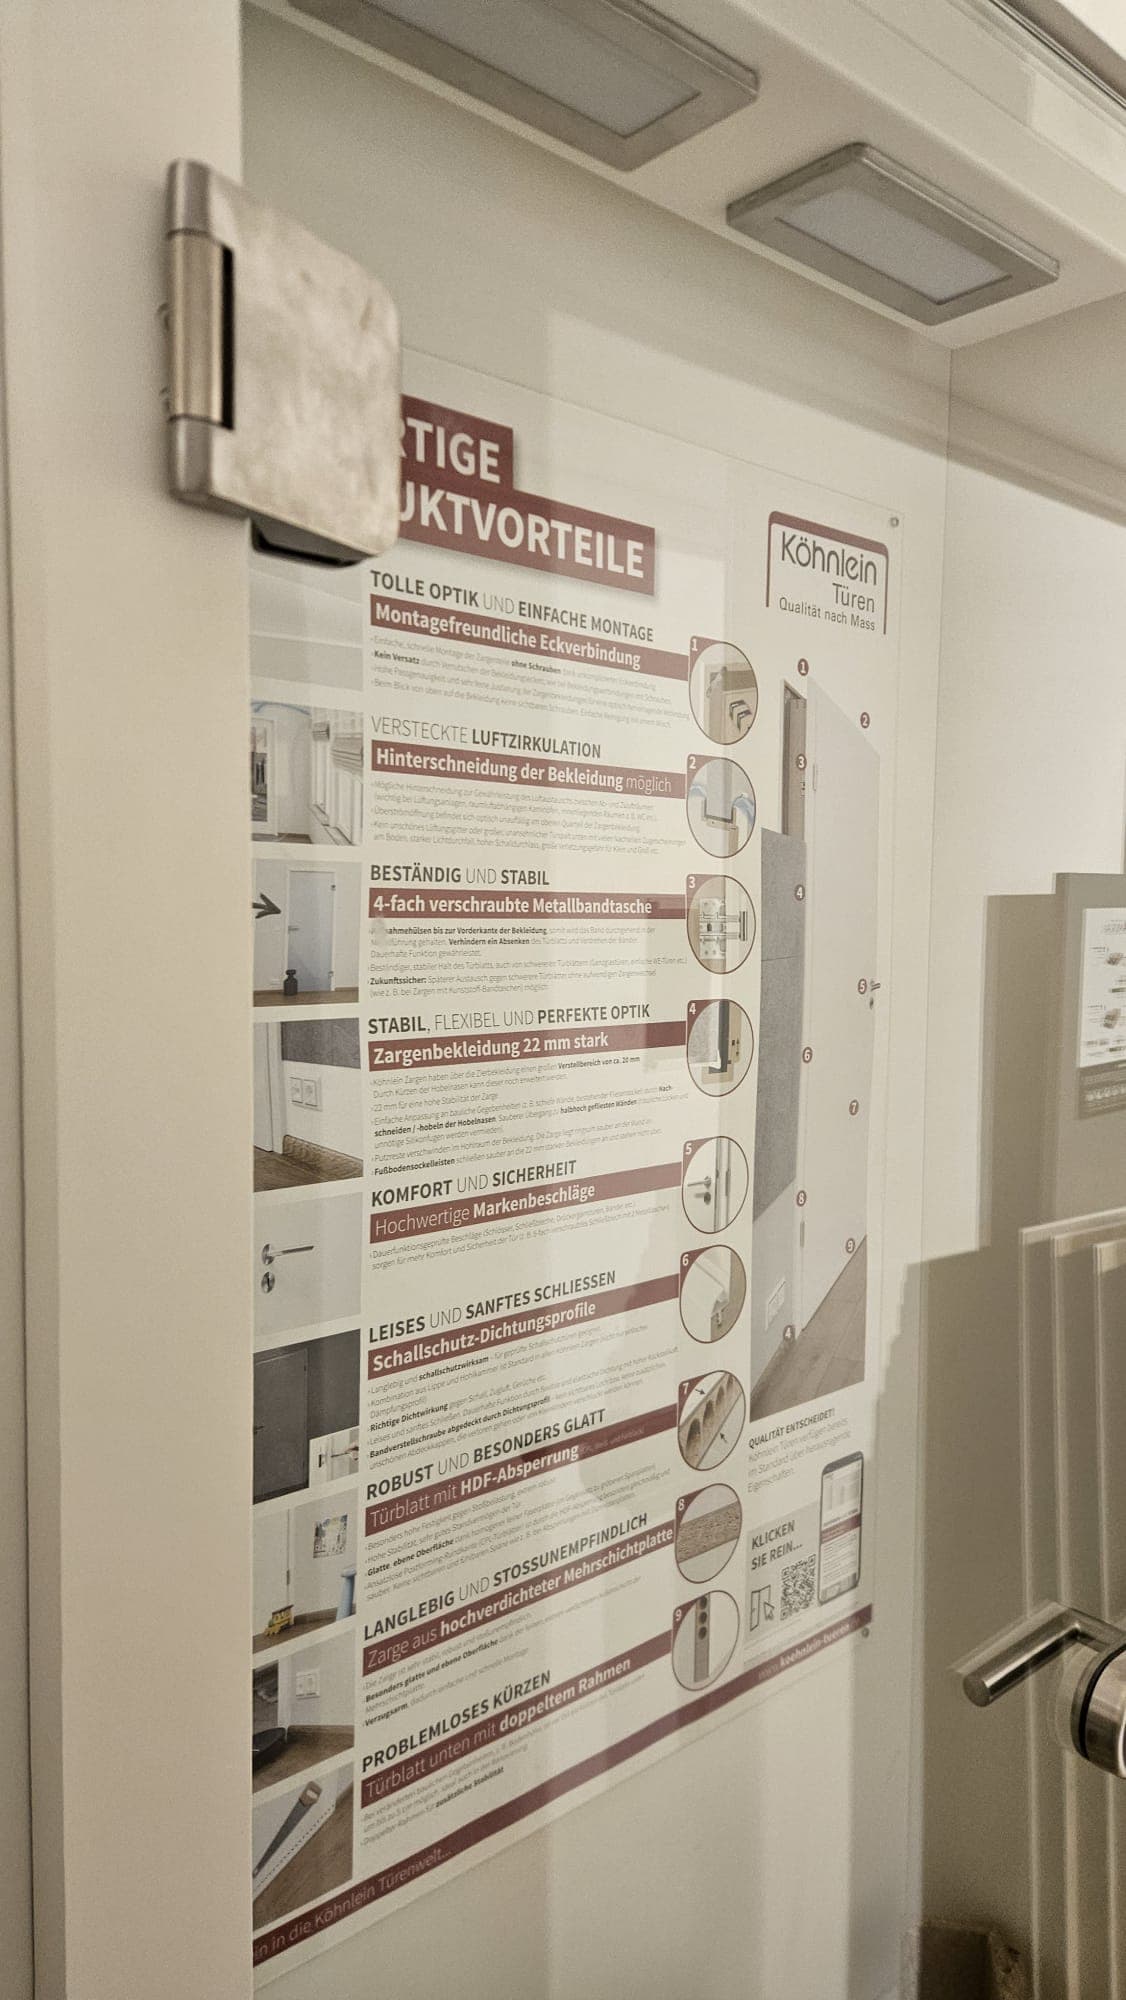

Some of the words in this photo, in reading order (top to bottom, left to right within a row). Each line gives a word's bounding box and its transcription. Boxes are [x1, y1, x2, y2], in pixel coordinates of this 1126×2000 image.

[400, 416, 501, 483] TIGE
[781, 531, 877, 586] Köhnlein
[370, 570, 425, 596] TOLLE
[428, 582, 480, 608] OPTIK
[482, 592, 515, 614] UND
[518, 600, 588, 629] EINFACHE
[590, 616, 655, 643] MONTAGE
[779, 596, 821, 618] Qualität
[824, 610, 848, 624] nach
[850, 613, 876, 631] Mass
[832, 582, 875, 613] Türen
[374, 602, 537, 649] Montagefreundliche
[539, 629, 641, 671] Eckverbindung
[691, 638, 699, 652] 1
[374, 649, 392, 660] Kein
[392, 653, 421, 665] Versatz
[370, 715, 469, 744] VERSTECKTE
[471, 728, 601, 759] LUFTZIRKULATION
[376, 747, 518, 782] Hinterschneidung
[520, 763, 546, 781] der
[547, 765, 625, 792] Bekleidung
[625, 775, 672, 795] möglich
[689, 755, 697, 770] 2
[370, 862, 462, 884] BESTÄNDIG
[464, 867, 498, 885] UND
[500, 868, 550, 886] STABIL
[688, 876, 696, 889] 3
[373, 895, 426, 912] 4-fach
[429, 896, 530, 913] verschraubte
[532, 897, 653, 914] Metallbandtasche
[433, 927, 445, 935] bis
[499, 927, 511, 935] der
[367, 1015, 431, 1035] STABIL,
[434, 1011, 500, 1031] FLEXIBEL
[503, 1010, 534, 1027] UND
[537, 1006, 608, 1025] PERFEKTE
[610, 1003, 651, 1020] OPTIK
[688, 1002, 697, 1015] 4
[373, 1038, 521, 1067] Zargenbekleidung
[523, 1037, 541, 1053] 22
[543, 1038, 571, 1051] mm
[573, 1031, 609, 1049] stark
[374, 1125, 412, 1137] schneiden
[416, 1121, 444, 1133] -hobeln
[444, 1120, 457, 1129] der
[457, 1115, 497, 1128] Hobelnasen
[684, 1142, 693, 1156] 5
[371, 1179, 453, 1207] KOMFORT
[456, 1174, 489, 1193] UND
[492, 1159, 577, 1187] SICHERHEIT
[374, 1157, 456, 1176] Fußbodensockelleisten
[375, 1207, 471, 1237] Hochwertige
[472, 1183, 596, 1219] Markenbeschläge
[681, 1253, 690, 1267] 6
[369, 1315, 426, 1344] LEISES
[429, 1307, 462, 1329] UND
[465, 1290, 531, 1320] SANFTES
[534, 1270, 616, 1303] SCHLIESSEN
[372, 1301, 597, 1372] Schallschutz-Dichtungsprofile
[418, 1356, 489, 1382] schallschutzwirksam
[682, 1382, 690, 1395] 7
[369, 1417, 400, 1433] Richtige
[401, 1403, 449, 1423] Dichtwirkung
[369, 1429, 447, 1458] Bandverstellschraube
[447, 1418, 482, 1434] abgedeckt
[482, 1411, 502, 1422] durch
[748, 1425, 786, 1449] QUALITÄT
[785, 1407, 836, 1434] ENTSCHEIDET!
[366, 1464, 434, 1501] ROBUST
[437, 1452, 470, 1476] UND
[473, 1422, 561, 1464] BESONDERS
[563, 1408, 606, 1434] GLATT
[370, 1494, 431, 1528] Türblatt
[433, 1484, 458, 1505] mit
[460, 1444, 580, 1496] HDF-Absperrung
[677, 1498, 685, 1511] 8
[751, 1520, 796, 1550] KLICKEN
[392, 1553, 416, 1568] ebene
[751, 1552, 767, 1571] SIE
[769, 1540, 803, 1562] REIN...
[364, 1590, 455, 1641] LANGLEBIG
[458, 1576, 491, 1601] UND
[493, 1512, 648, 1587] STOSSUNEMPFINDLICH
[367, 1640, 410, 1668] Zarge
[412, 1628, 438, 1650] aus
[440, 1576, 562, 1638] hochverdichteter
[564, 1527, 674, 1585] Mehrschichtplatte
[675, 1608, 683, 1622] 9
[365, 1681, 404, 1703] Besonders
[404, 1672, 426, 1688] glatte
[426, 1664, 441, 1677] und
[441, 1655, 462, 1669] ebene
[462, 1638, 499, 1659] Oberfläche
[361, 1698, 489, 1774] PROBLEMLOSES
[492, 1670, 551, 1710] KÜRZEN
[366, 1758, 427, 1798] Türblatt
[428, 1738, 471, 1768] unten
[473, 1724, 497, 1745] mit
[499, 1687, 576, 1732] doppeltem
[578, 1658, 632, 1694] Rahmen
[288, 1920, 313, 1942] die
[314, 1883, 376, 1927] Köhnlein
